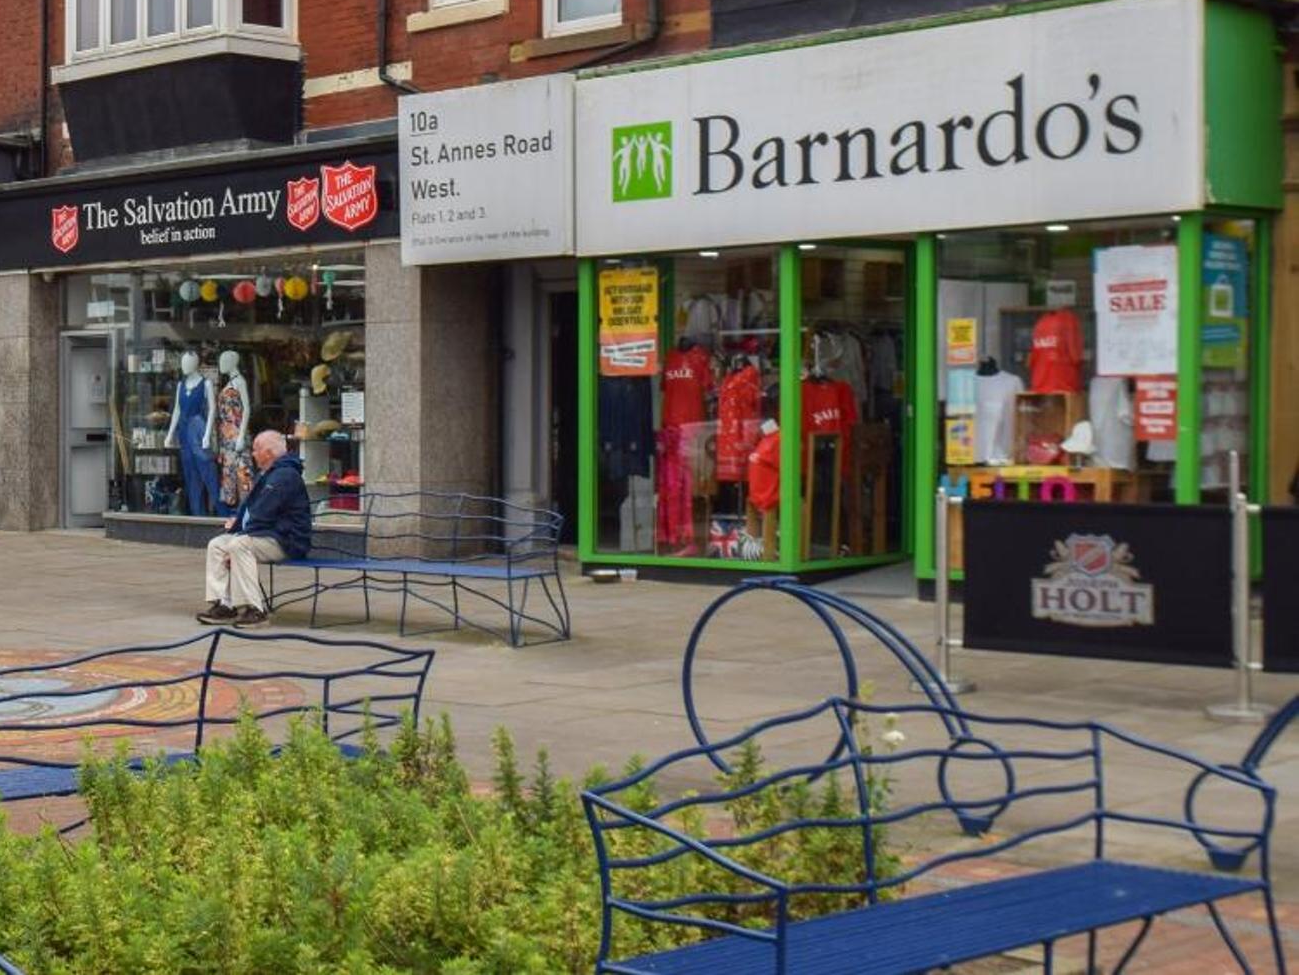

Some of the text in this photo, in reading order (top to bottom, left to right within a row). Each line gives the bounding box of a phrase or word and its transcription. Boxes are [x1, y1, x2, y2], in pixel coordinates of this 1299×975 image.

[410, 111, 439, 133] 10a
[692, 73, 1143, 196] Barnardo's
[411, 130, 552, 167] St. Annes Road
[334, 170, 354, 190] THE
[411, 178, 461, 201] West.
[327, 175, 372, 211] SALVATION
[82, 186, 281, 232] The Salvation Army
[343, 193, 371, 222] ARMY
[456, 208, 476, 221] and
[139, 224, 216, 246] belief in action
[1109, 293, 1167, 313] SALE
[666, 367, 694, 380] SALE
[1039, 587, 1145, 614] HOLT
